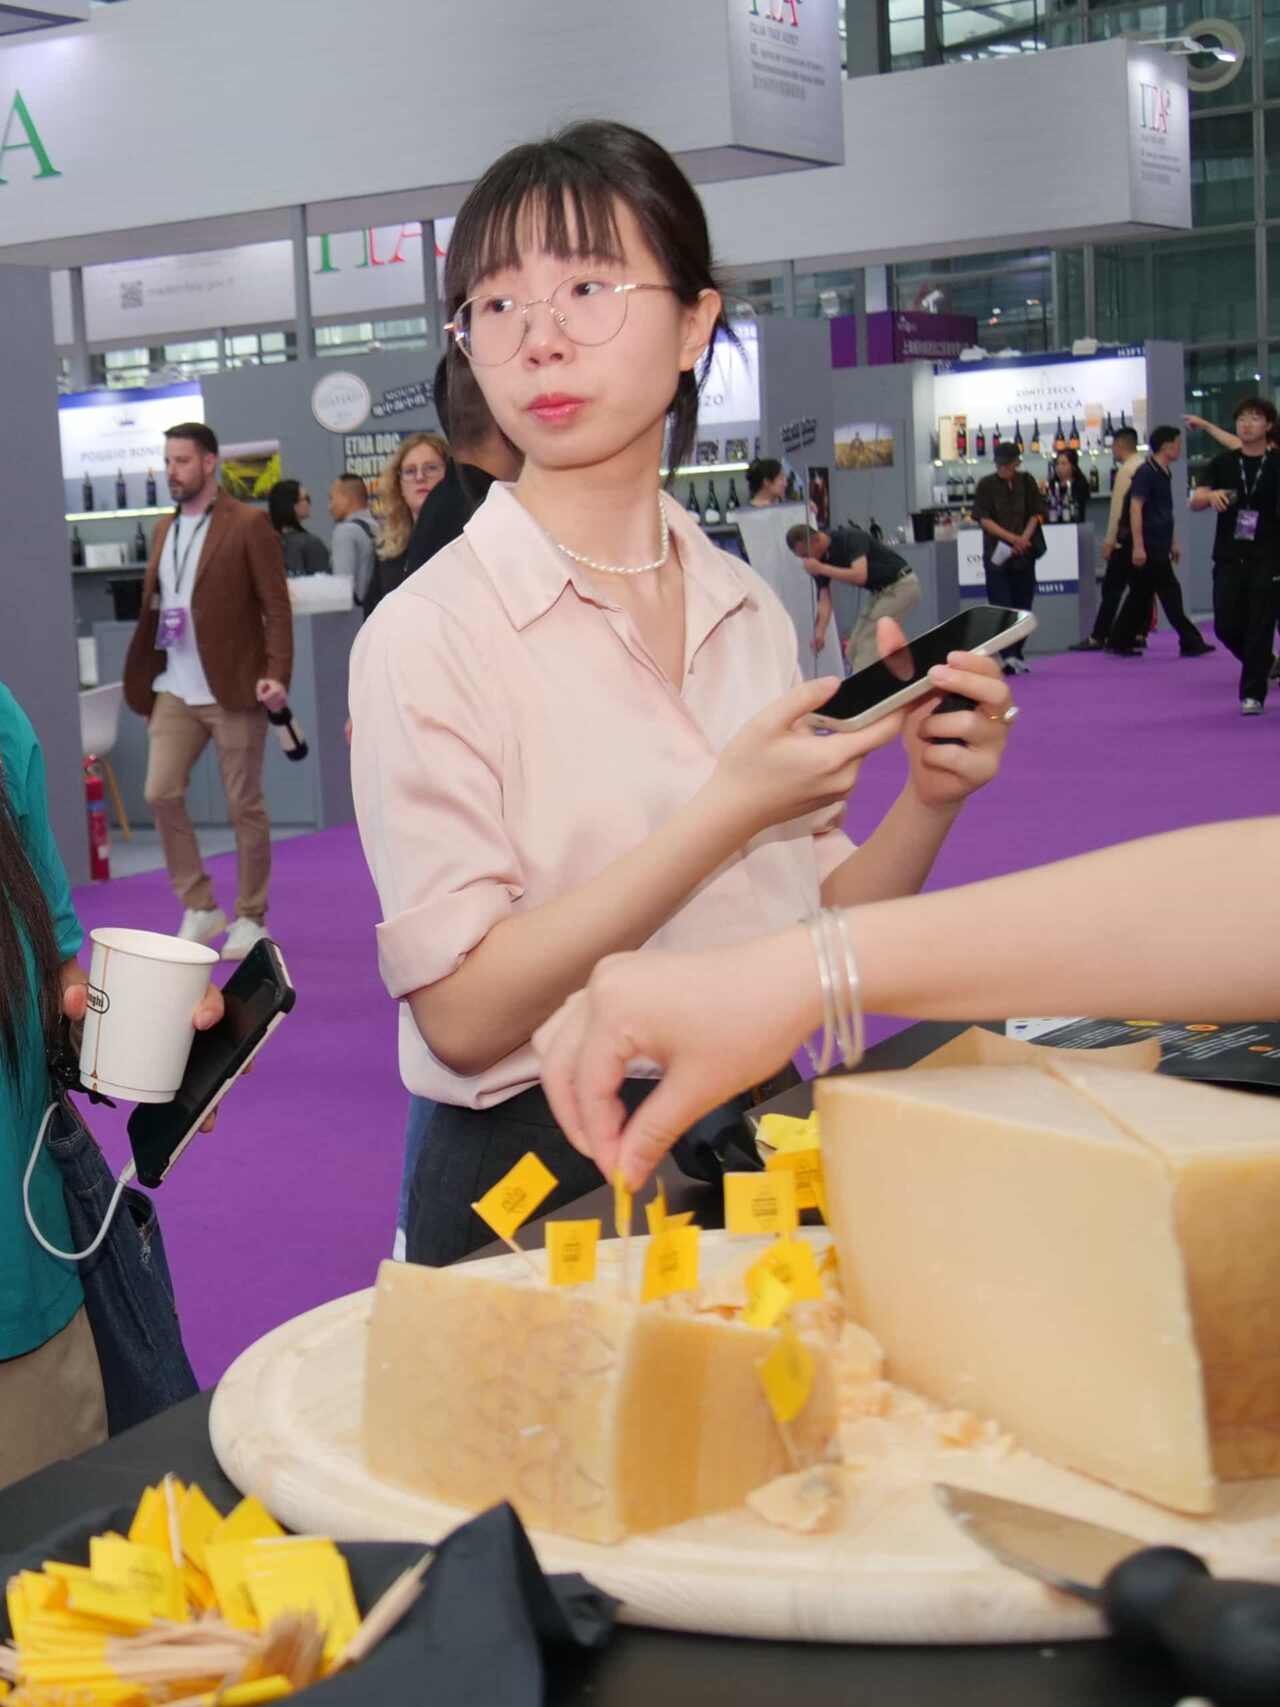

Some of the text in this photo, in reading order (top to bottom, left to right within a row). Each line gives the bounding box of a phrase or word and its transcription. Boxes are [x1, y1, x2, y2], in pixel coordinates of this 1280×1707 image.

[1007, 399, 1082, 414] CONTI ZECCA
[345, 434, 374, 456] ETNA
